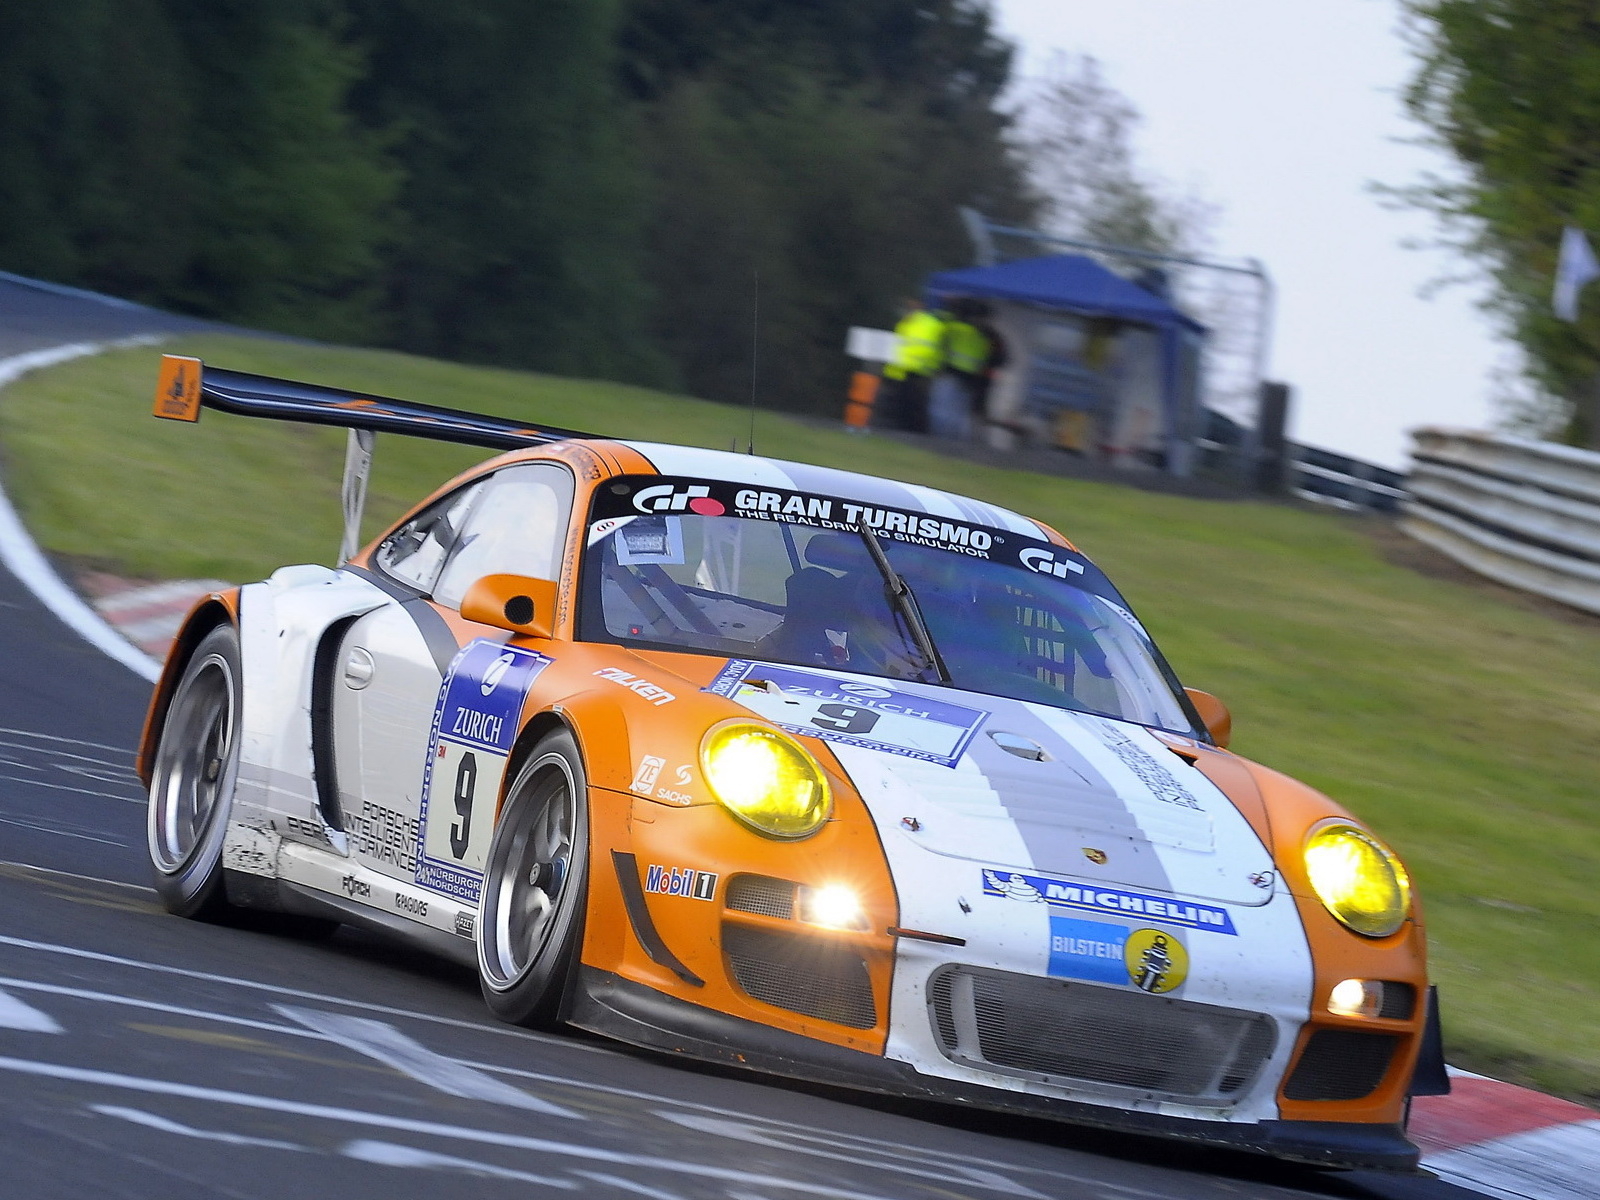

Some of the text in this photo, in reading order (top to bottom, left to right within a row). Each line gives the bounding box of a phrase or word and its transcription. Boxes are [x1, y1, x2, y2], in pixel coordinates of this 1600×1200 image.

[734, 508, 771, 521] THE
[774, 514, 819, 528] REAL
[894, 532, 991, 560] SIMULATOR
[735, 489, 992, 551] GRAN TURISMO
[592, 667, 676, 706] FALKEN
[784, 685, 930, 718] ZURICH
[452, 706, 504, 744] ZURICH
[810, 703, 881, 734] 9
[450, 751, 478, 860] 9
[657, 788, 693, 806] SACHS
[362, 800, 420, 836] PORSCHE
[646, 865, 694, 896] Mobil
[1046, 883, 1225, 926] MICHELIN
[1052, 935, 1124, 961] BILSTEIN
